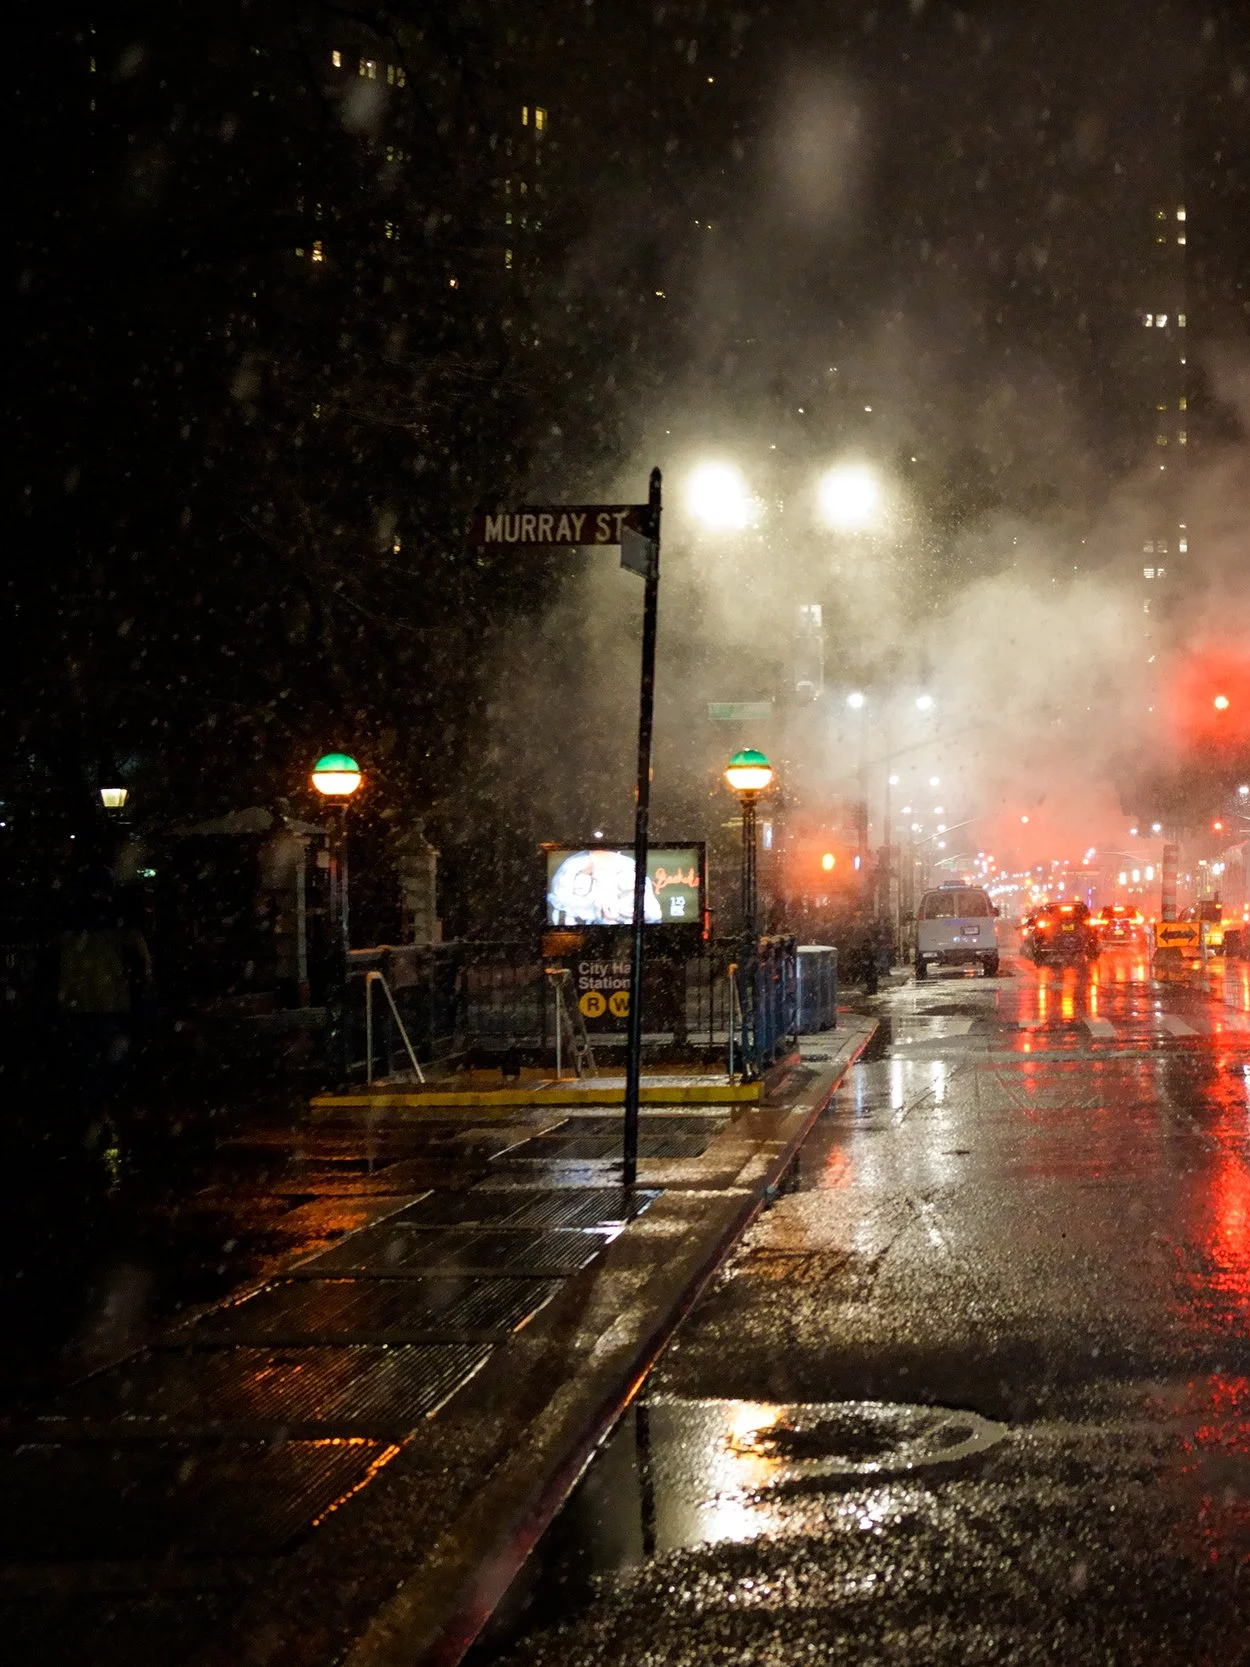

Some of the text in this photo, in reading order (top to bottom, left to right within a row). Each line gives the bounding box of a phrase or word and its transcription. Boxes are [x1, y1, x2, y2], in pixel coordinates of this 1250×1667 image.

[485, 511, 629, 543] MURRAY ST
[578, 962, 632, 977] City Ha
[578, 976, 631, 989] Station
[587, 997, 600, 1011] R
